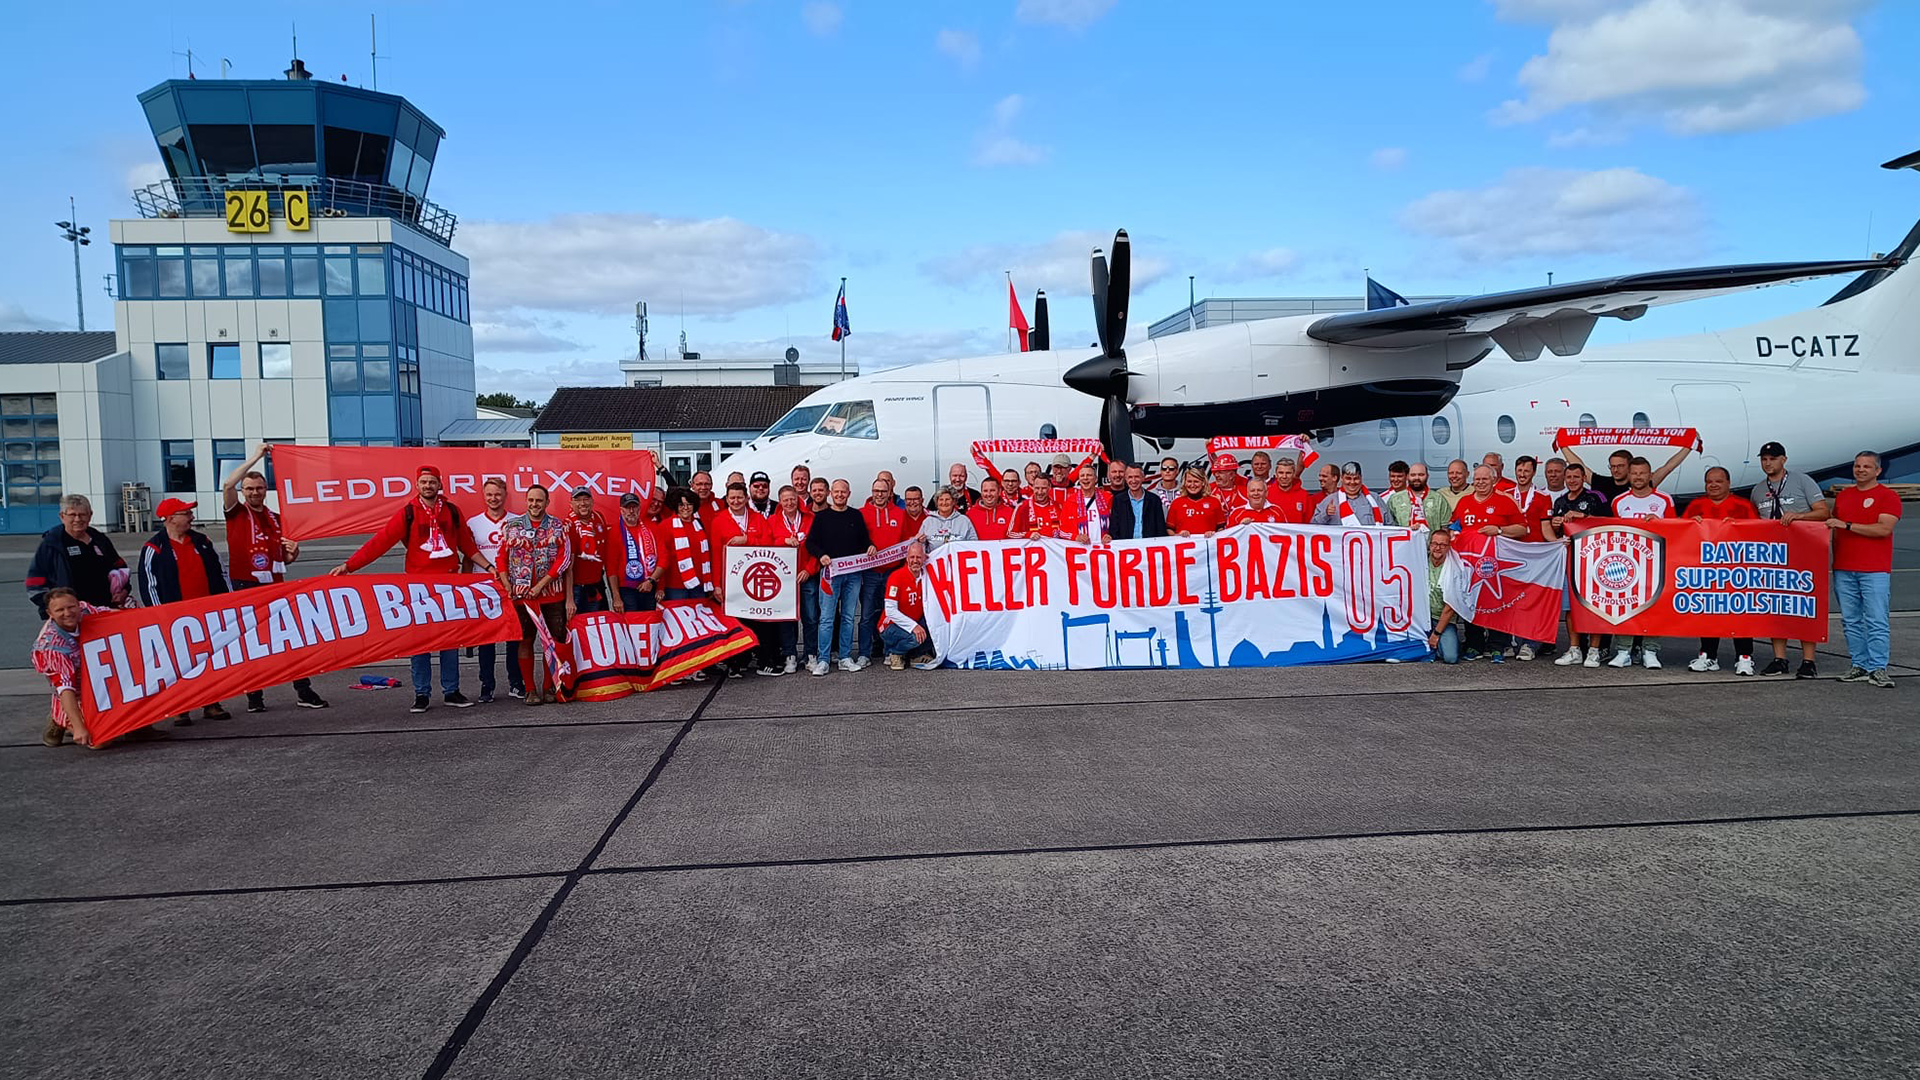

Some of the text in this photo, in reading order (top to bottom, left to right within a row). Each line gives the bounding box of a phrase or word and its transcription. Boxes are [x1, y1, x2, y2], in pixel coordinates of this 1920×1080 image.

[228, 195, 266, 227] 26
[1756, 335, 1860, 357] D-CATZ
[1213, 436, 1270, 449] SAN MIA
[1580, 434, 1671, 445] BAYERN MÜNCHEN
[1663, 428, 1687, 437] VON
[284, 466, 651, 505] LEDDRÜXXEN
[1580, 537, 1654, 559] BAYERN SUPPORTERS
[1701, 542, 1788, 566] BAYERN
[730, 559, 745, 576] Es
[1065, 541, 1199, 608] FÖRDE
[1216, 534, 1334, 603] BAZIS
[1675, 567, 1814, 592] SUPPORTERS
[1591, 593, 1638, 605] OSTHOLSTEIN
[1673, 592, 1816, 618] OSTHOLSTEIN
[750, 607, 773, 616] 2015
[82, 587, 369, 713] FLACHLAND
